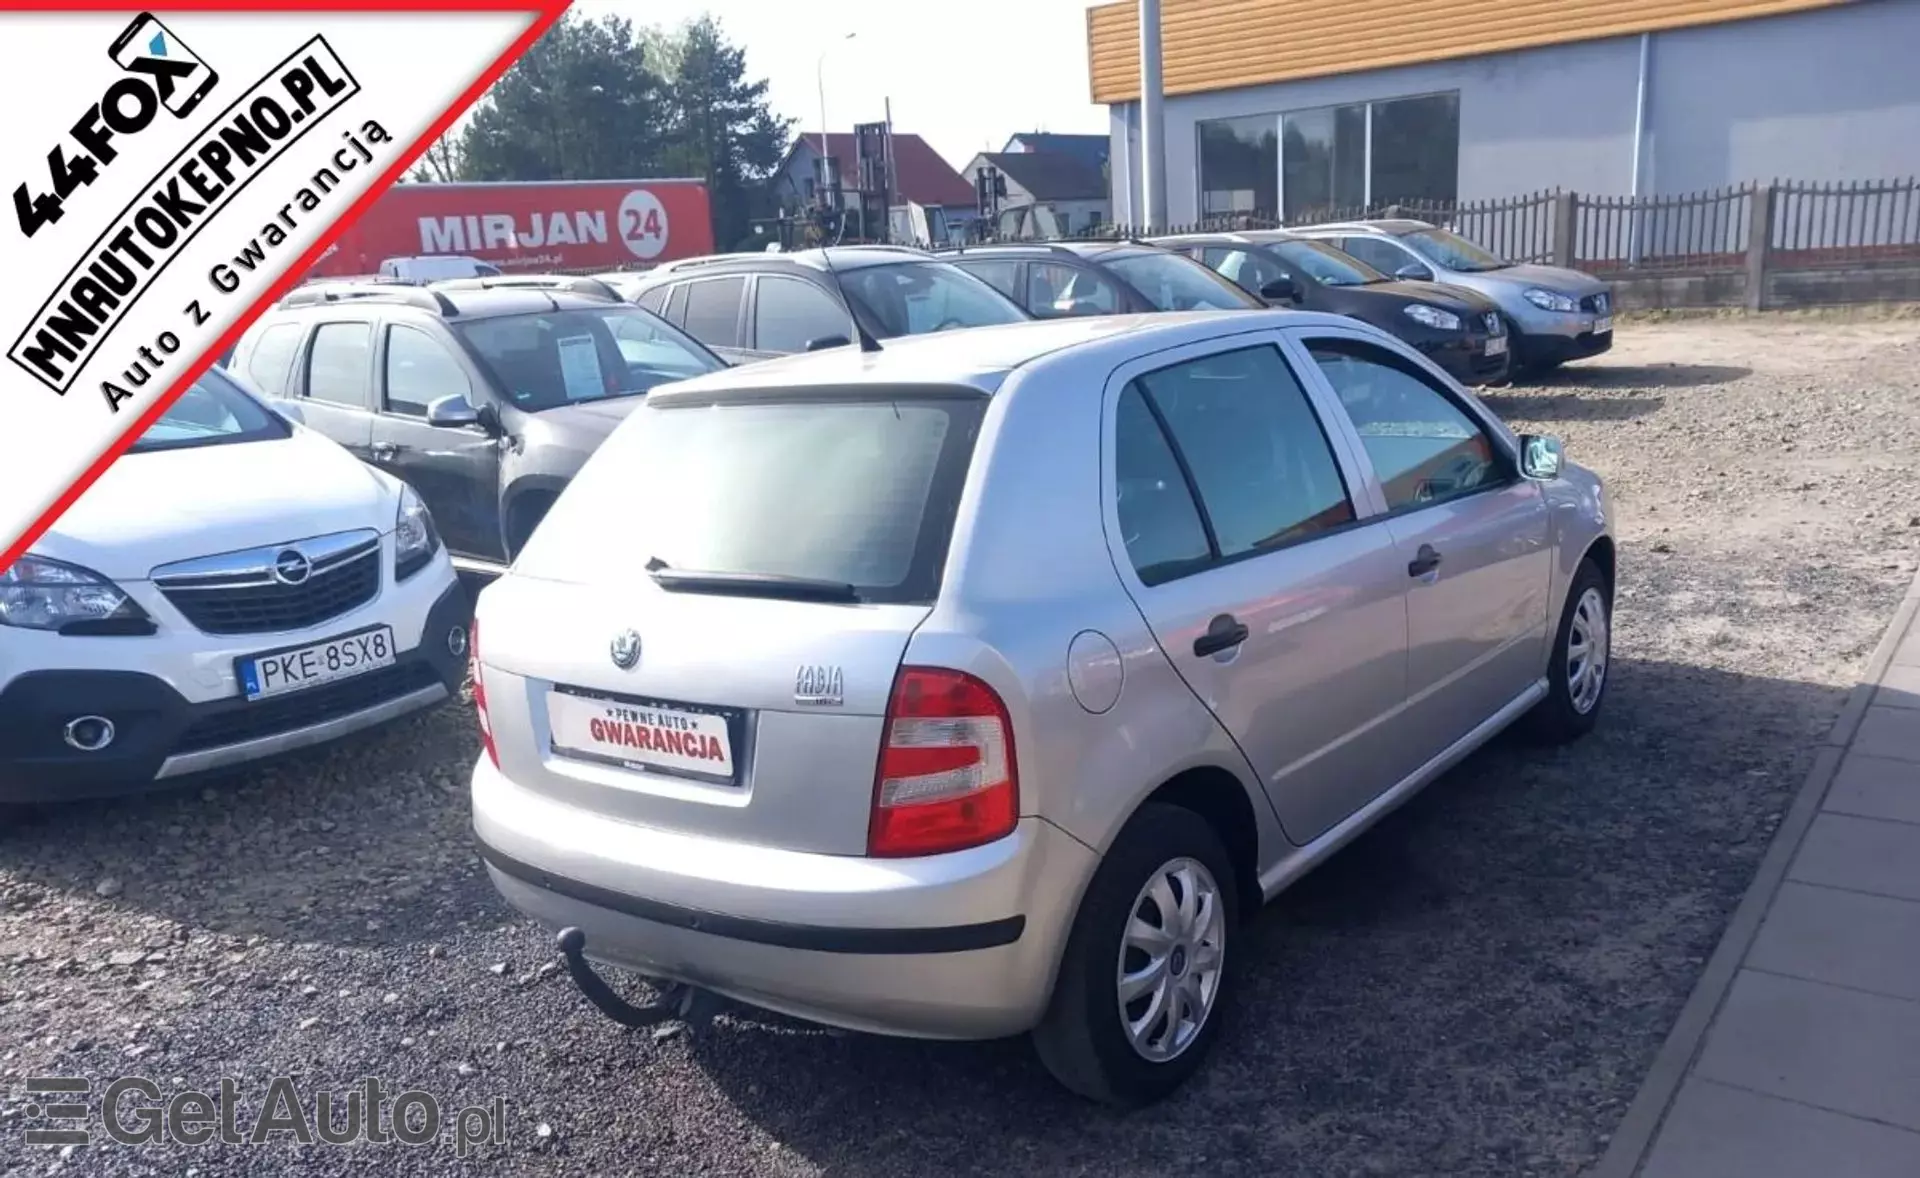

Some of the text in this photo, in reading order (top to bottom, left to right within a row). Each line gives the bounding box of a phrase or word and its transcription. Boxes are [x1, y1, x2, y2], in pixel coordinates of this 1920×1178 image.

[418, 208, 662, 253] MIRJAN 24
[262, 651, 318, 688] PKE
[326, 633, 388, 671] 8SX8
[795, 664, 843, 694] FABIA
[590, 718, 725, 762] GWARANCJA
[615, 708, 689, 730] PEWNE AUTO
